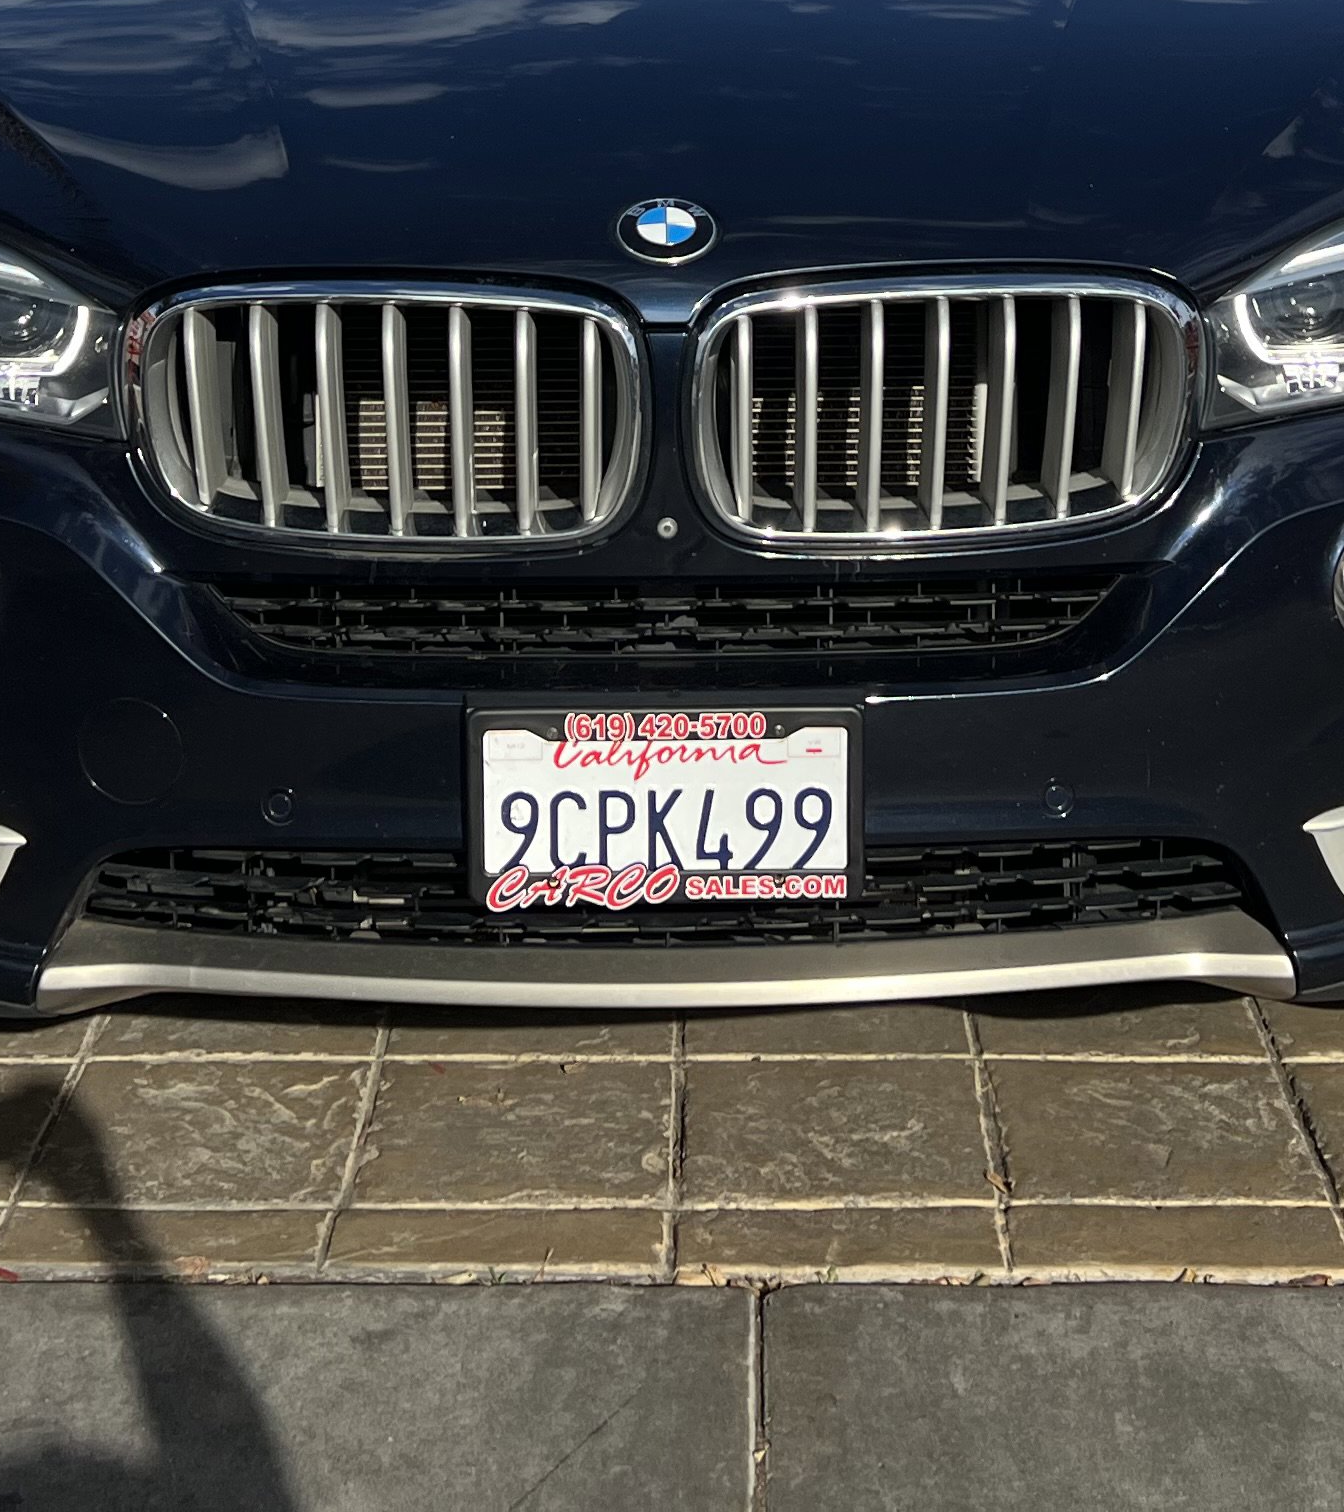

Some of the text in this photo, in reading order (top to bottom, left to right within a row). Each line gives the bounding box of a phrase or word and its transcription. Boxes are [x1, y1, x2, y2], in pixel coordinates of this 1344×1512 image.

[563, 711, 768, 742] (619) 420-5700
[552, 738, 789, 782] California
[499, 786, 834, 874] 9CPK499
[485, 862, 848, 913] CARCO SALES.COM
